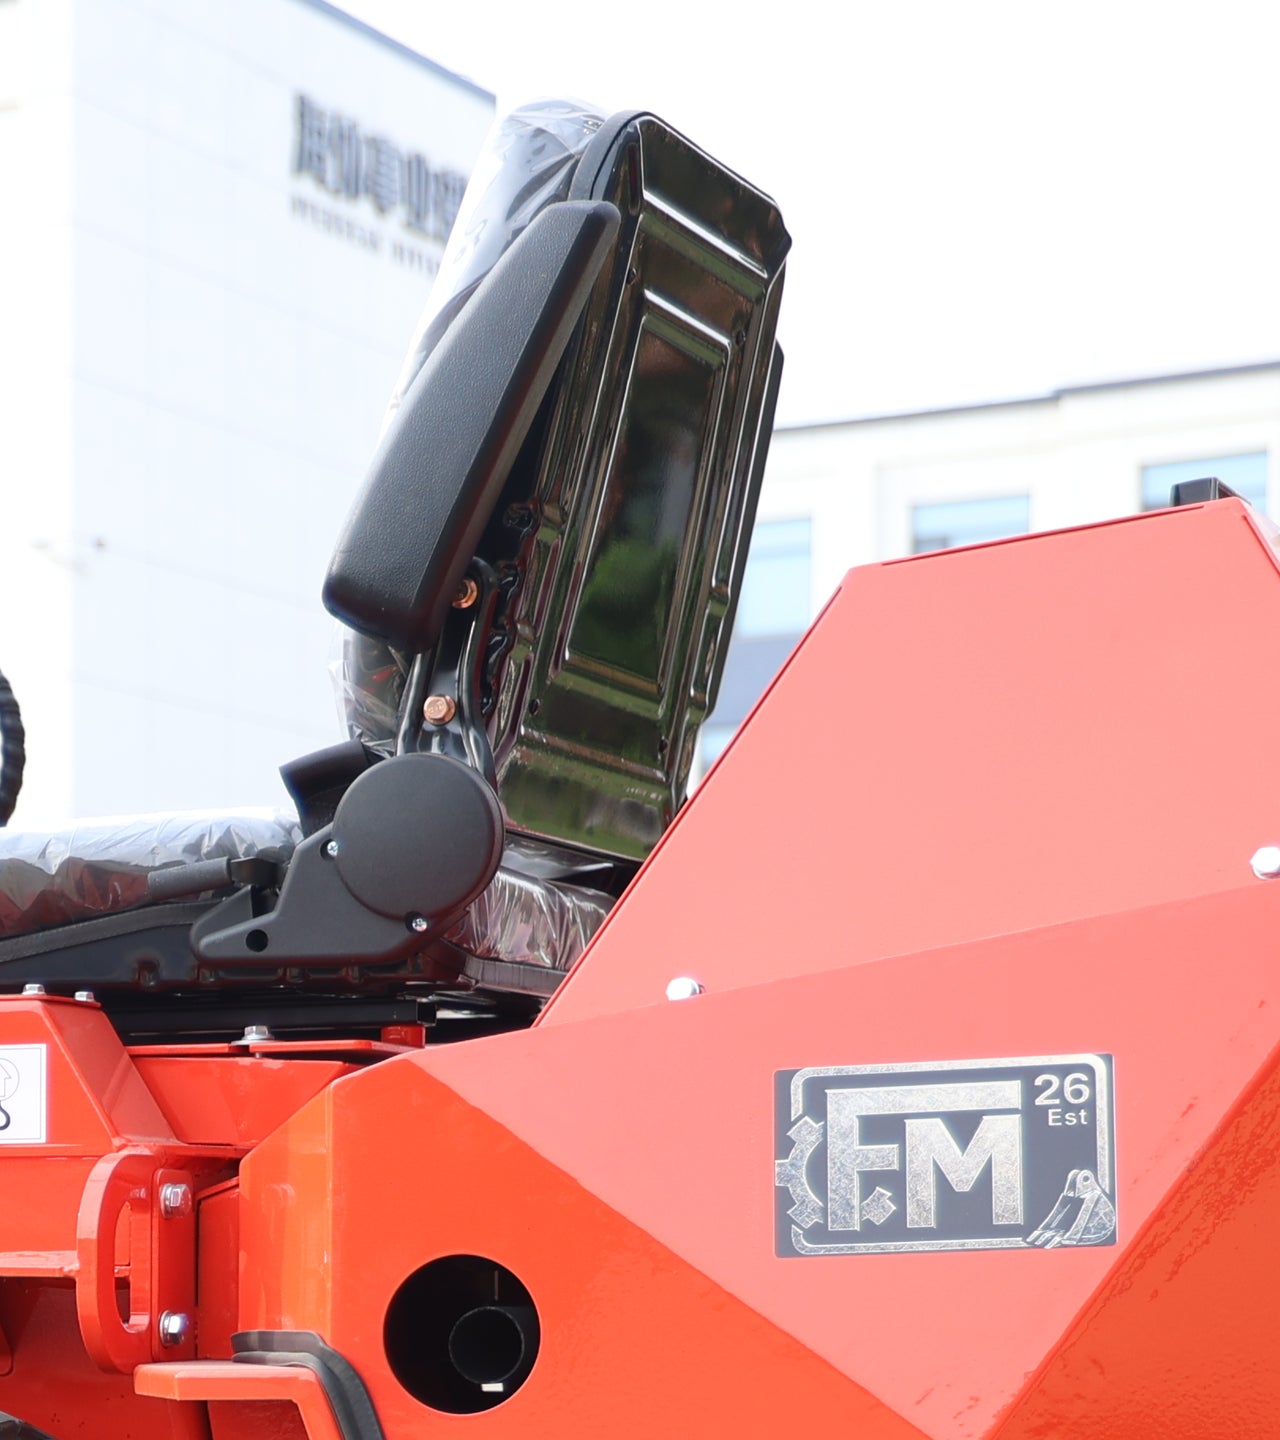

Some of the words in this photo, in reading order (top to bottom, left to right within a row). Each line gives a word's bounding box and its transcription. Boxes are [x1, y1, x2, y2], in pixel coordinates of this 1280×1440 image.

[1033, 1073, 1090, 1107] 26
[1047, 1108, 1088, 1127] Est
[824, 1080, 1023, 1231] FM
